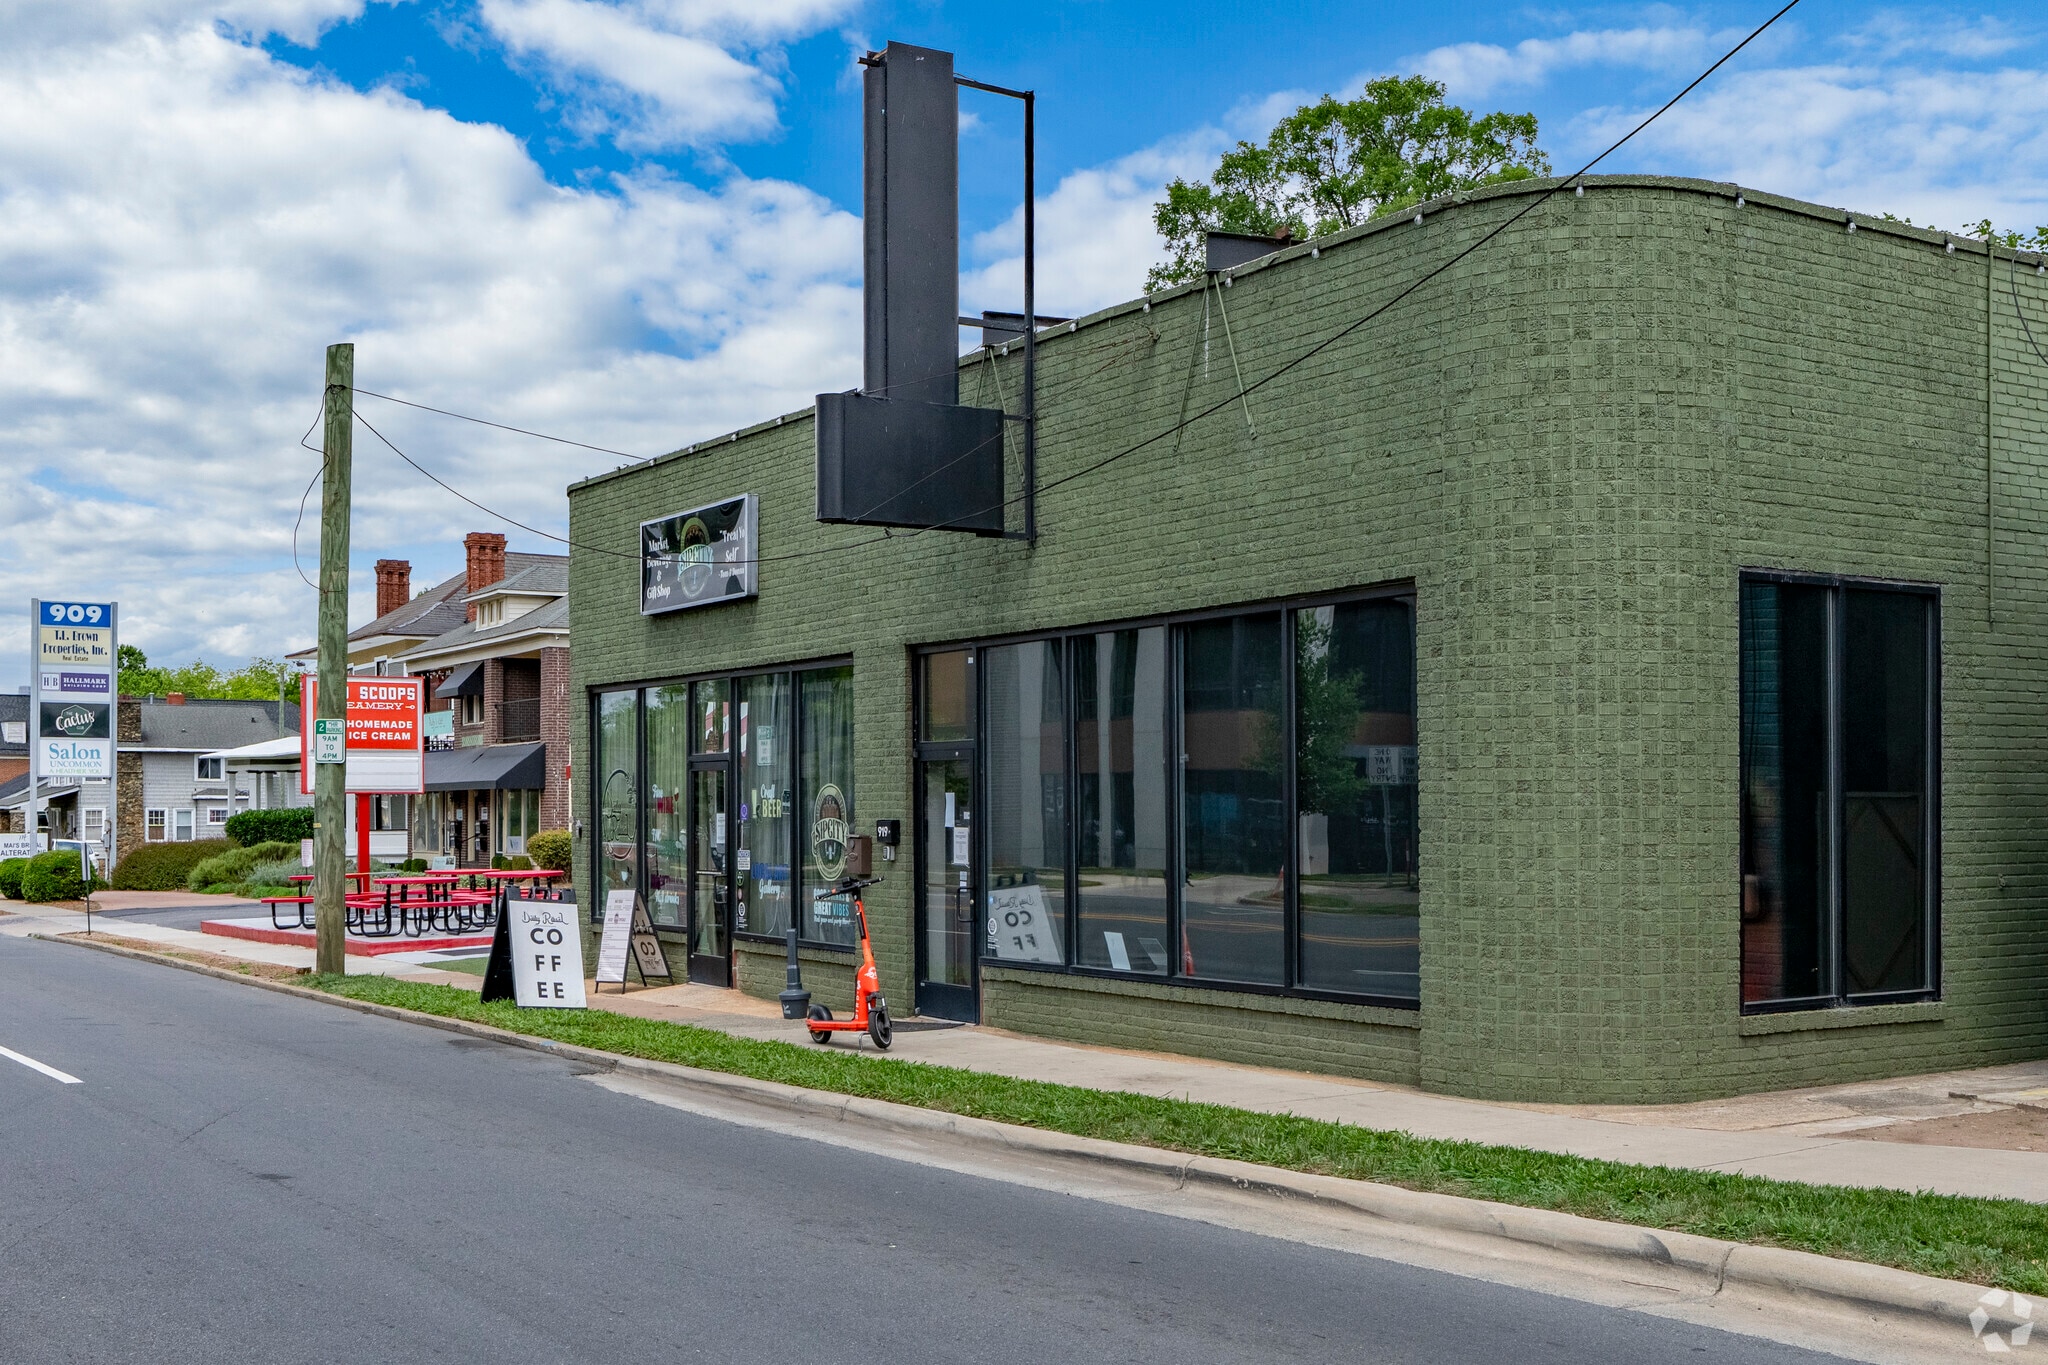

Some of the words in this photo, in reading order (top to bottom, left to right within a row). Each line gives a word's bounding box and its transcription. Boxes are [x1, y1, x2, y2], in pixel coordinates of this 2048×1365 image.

[657, 584, 670, 600] Shop
[50, 604, 102, 623] 909
[73, 631, 98, 641] Brown
[92, 645, 108, 655] Inc.
[360, 686, 415, 700] SCOOPS
[347, 702, 404, 710] EAMERY
[56, 711, 94, 730] Cactus
[319, 723, 324, 732] 2
[347, 720, 412, 729] HOMEMADE
[349, 732, 367, 740] ICE
[371, 732, 411, 740] CREAM
[49, 742, 101, 759] Salon
[762, 799, 782, 818] BEER
[815, 818, 846, 846] SIPCITY
[814, 901, 832, 915] GREAT
[832, 903, 849, 917] VIBES
[530, 928, 563, 945] CO
[535, 955, 561, 972] FF
[537, 982, 564, 998] EE
